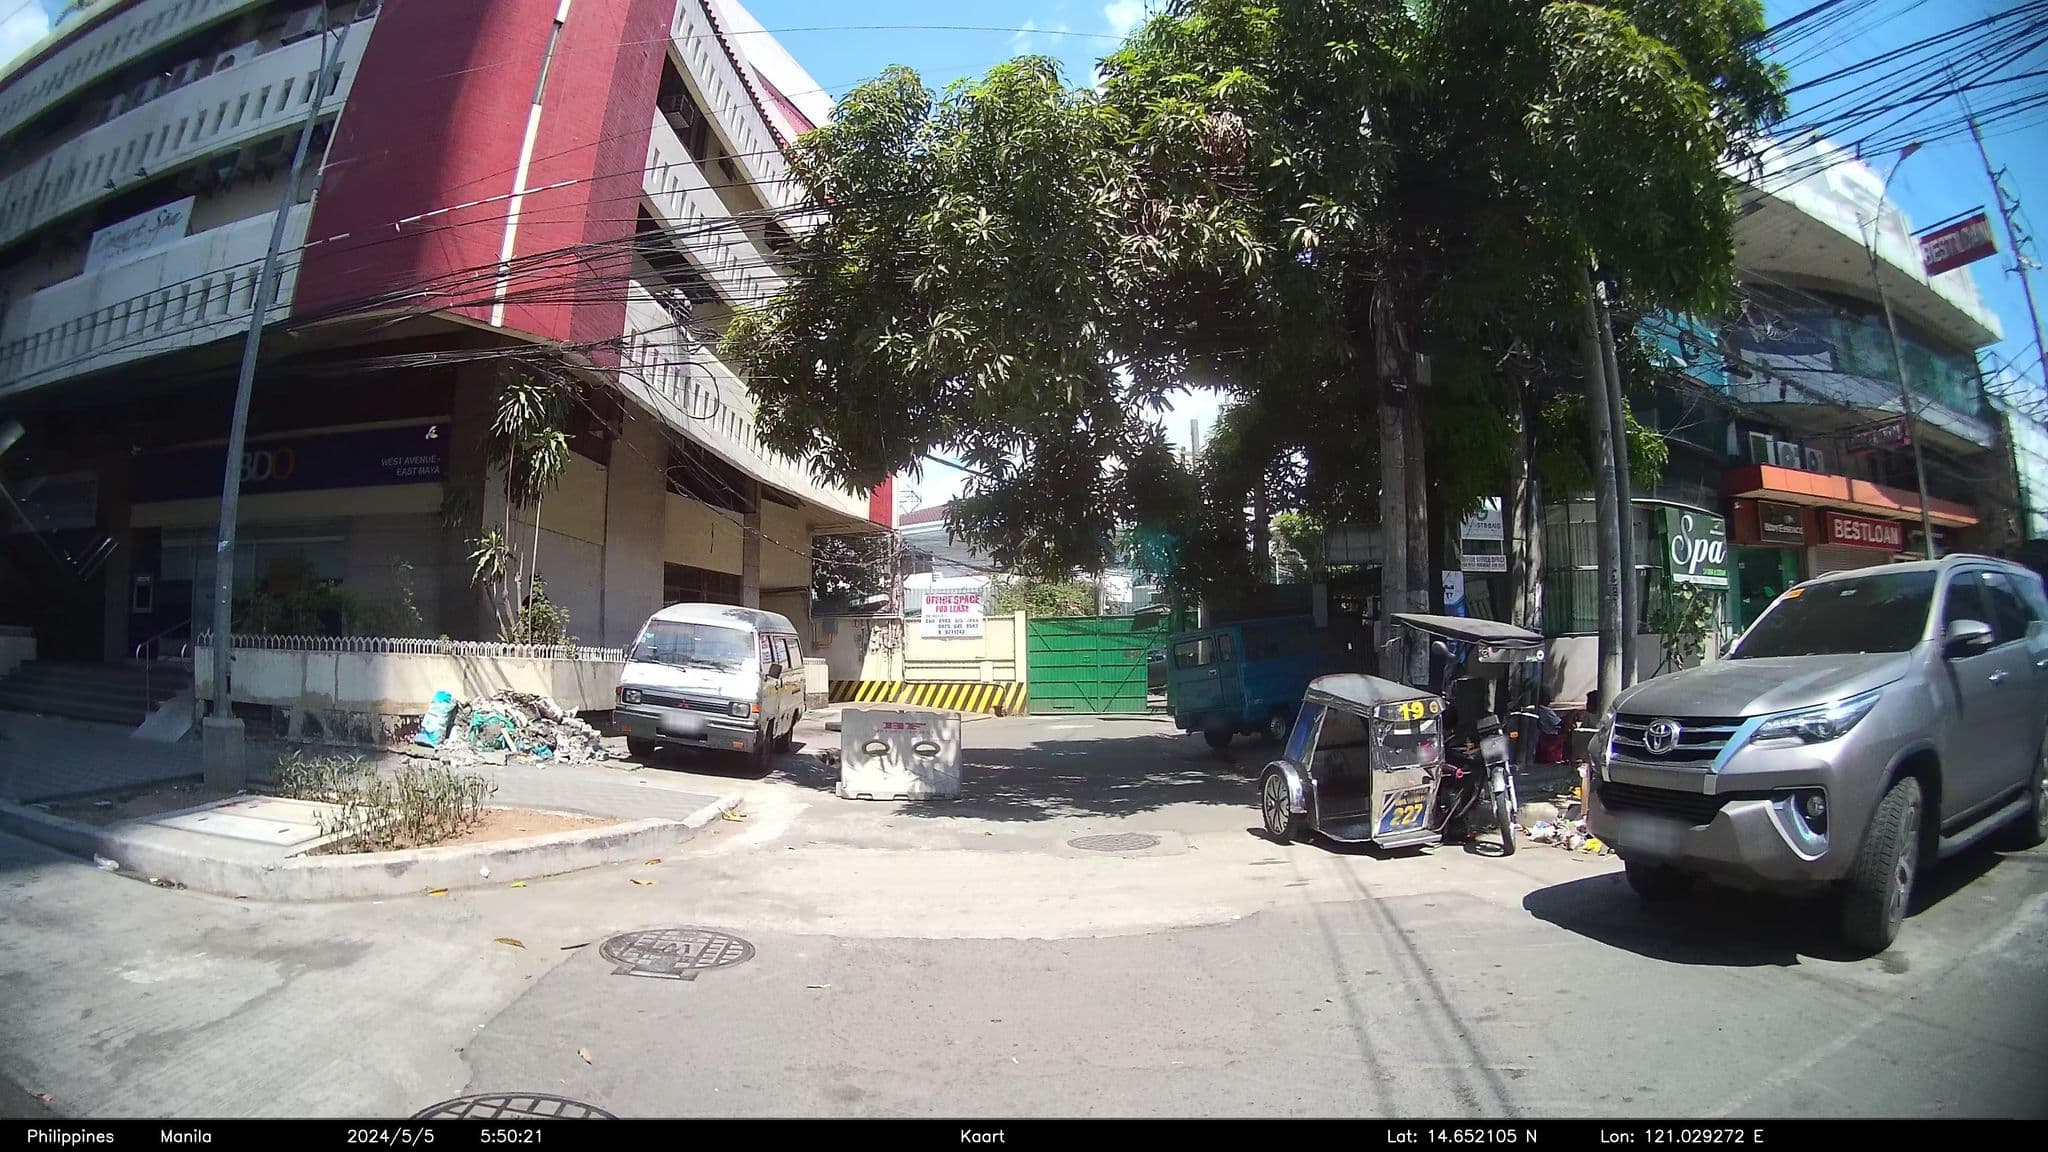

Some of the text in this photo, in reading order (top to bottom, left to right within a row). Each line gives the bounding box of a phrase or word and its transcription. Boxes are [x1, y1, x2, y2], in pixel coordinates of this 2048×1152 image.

[381, 456, 402, 467] WEST
[397, 467, 416, 476] EAST
[1833, 518, 1899, 545] BESTLOAN
[1671, 514, 1727, 574] Spa
[925, 594, 981, 605] OFFICE SPACE
[1399, 701, 1425, 720] 19
[1389, 803, 1424, 825] 227
